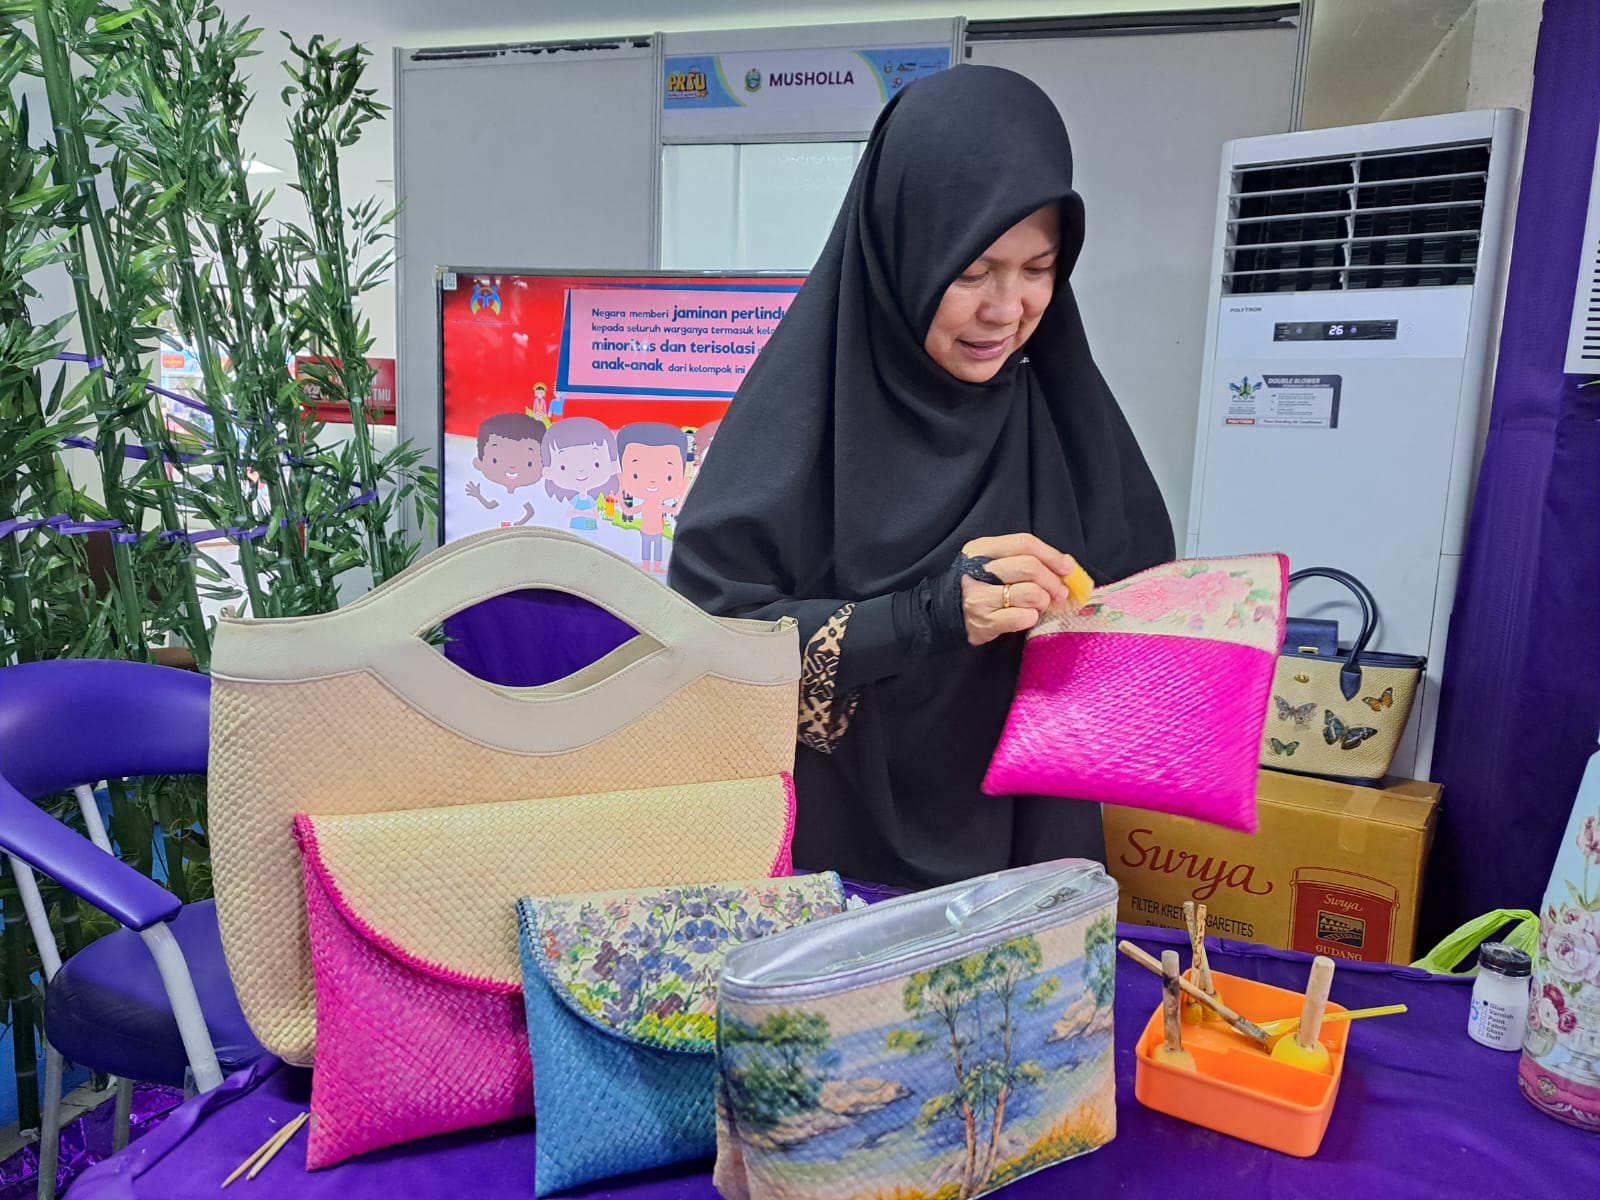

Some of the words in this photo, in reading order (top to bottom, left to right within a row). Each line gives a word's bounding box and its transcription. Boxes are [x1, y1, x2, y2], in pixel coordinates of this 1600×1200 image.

[769, 71, 854, 87] MUSHOLLA
[592, 308, 626, 319] Negara
[629, 309, 669, 318] memberi
[671, 305, 727, 322] jaminan
[592, 322, 624, 333] kepada
[627, 323, 661, 332] seluruh
[664, 327, 708, 336] warganya
[711, 325, 753, 334] termasuk
[1329, 325, 1344, 336] 26
[592, 338, 656, 352] minoritas
[660, 339, 686, 352] dan
[690, 341, 755, 354] terisolasi
[592, 356, 663, 371] anak-anak
[668, 363, 687, 372] dari
[689, 364, 732, 375] kelompok
[735, 365, 746, 374] ini
[1120, 828, 1273, 901] Surya
[1323, 893, 1363, 912] Surya
[1131, 896, 1160, 914] FILTER
[1161, 903, 1187, 921] KRET
[1205, 914, 1254, 938] GARETTES
[1315, 944, 1363, 961] GUDANG
[1488, 1015, 1505, 1024] Paint
[1489, 1009, 1514, 1020] Varnish
[1487, 1021, 1507, 1031] Fabric
